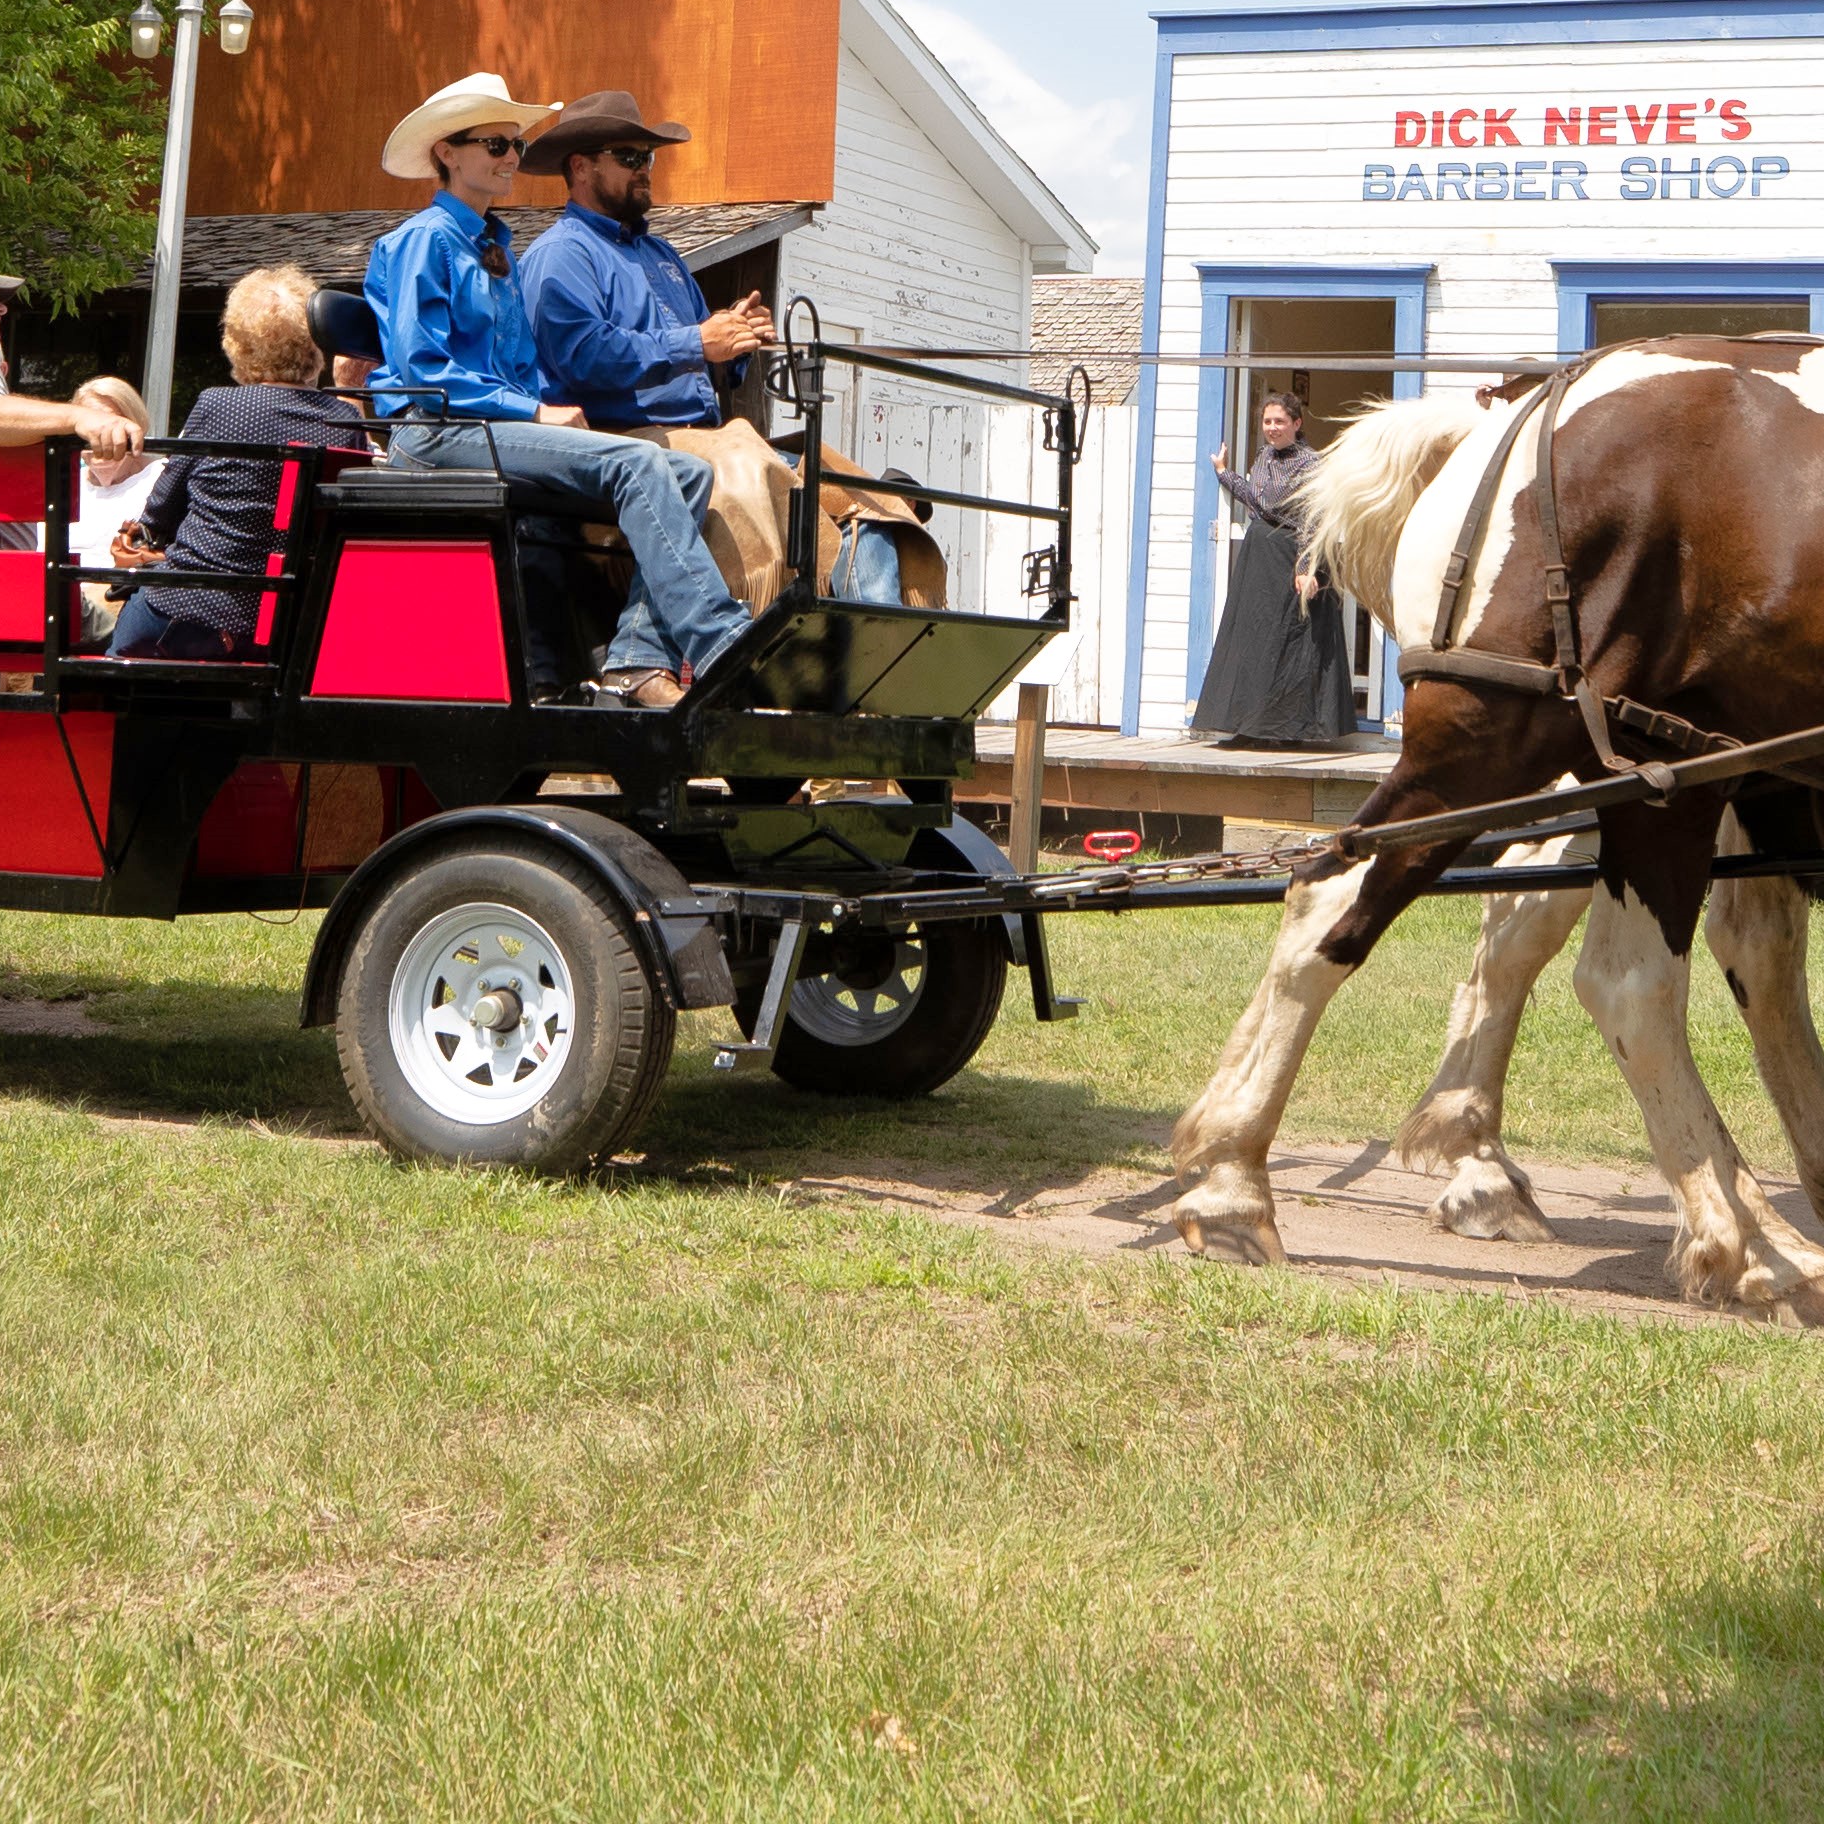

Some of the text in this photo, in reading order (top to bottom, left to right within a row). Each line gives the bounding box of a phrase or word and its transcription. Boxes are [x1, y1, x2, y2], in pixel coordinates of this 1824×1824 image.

[1394, 98, 1752, 147] DICK NEVE'S
[1362, 155, 1791, 201] BARBER SHOP
